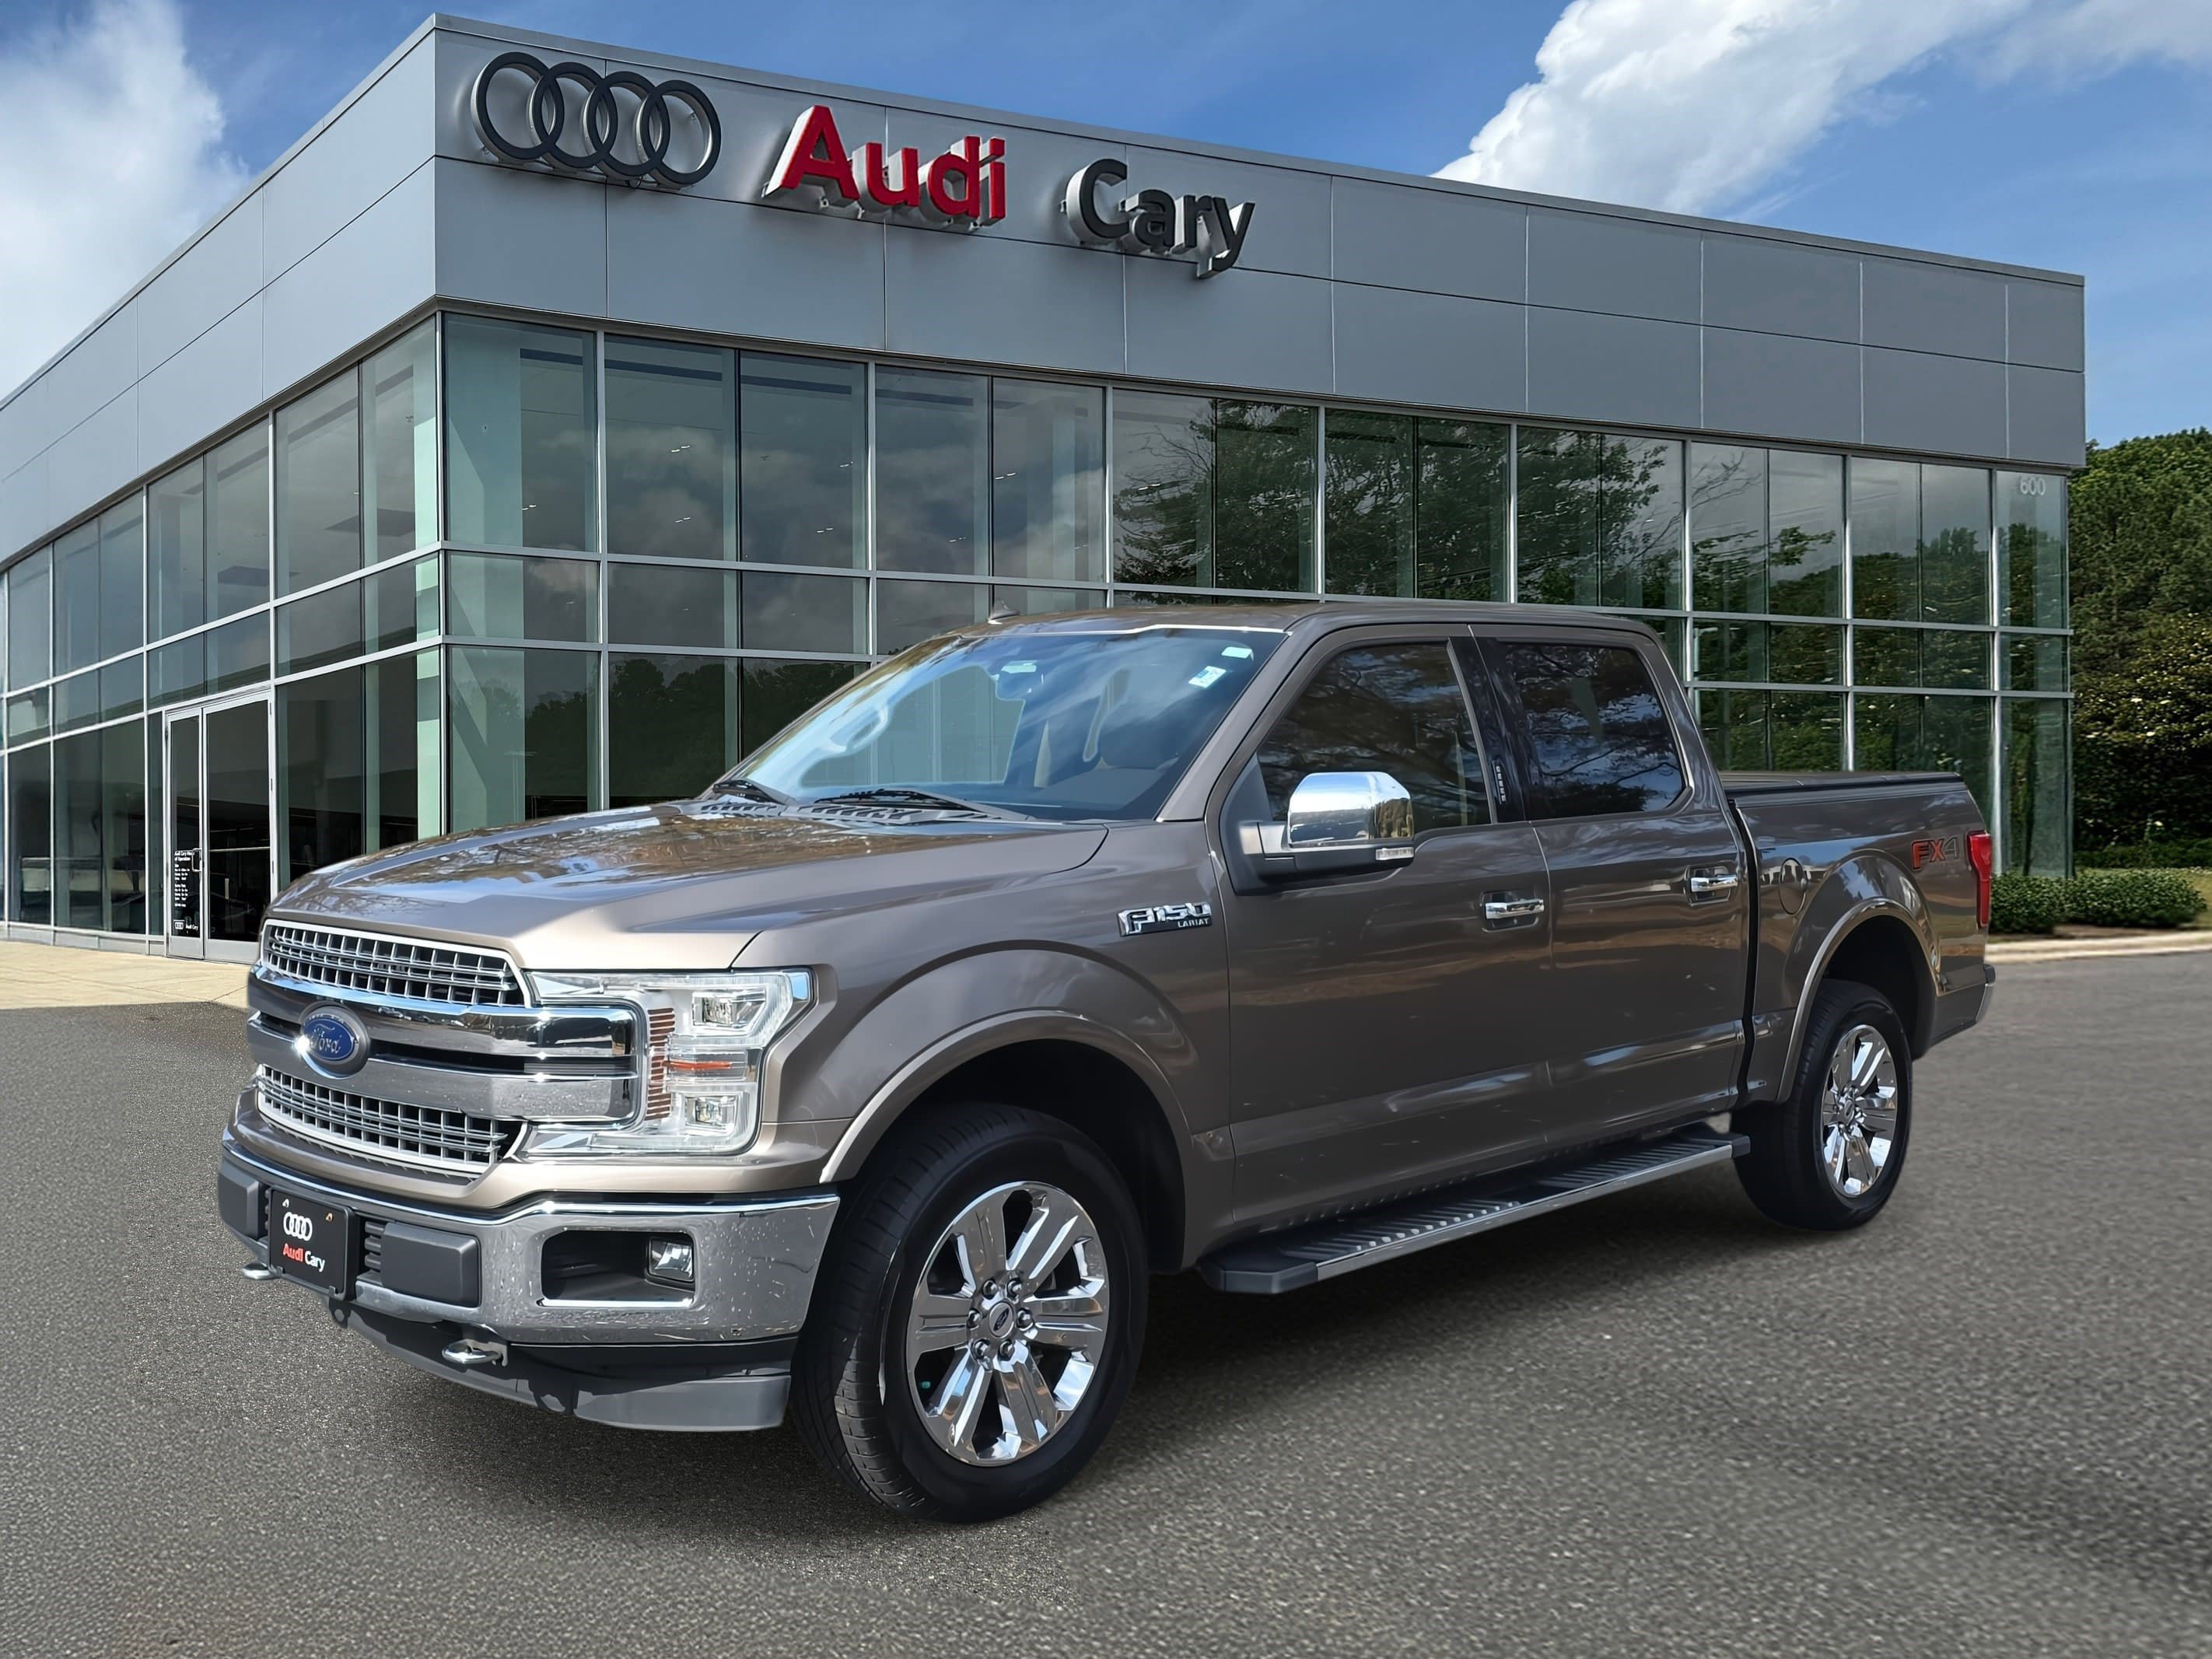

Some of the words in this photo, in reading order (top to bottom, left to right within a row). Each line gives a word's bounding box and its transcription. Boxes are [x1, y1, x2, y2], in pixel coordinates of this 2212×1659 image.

[768, 104, 1006, 226] Audi
[1069, 158, 1255, 276] Cary
[2020, 476, 2046, 496] 600
[1911, 835, 1958, 870] FX4
[1177, 919, 1209, 928] LARIAT
[311, 1024, 341, 1055] Ford
[282, 1243, 303, 1262] Audi
[304, 1250, 325, 1272] Cary
